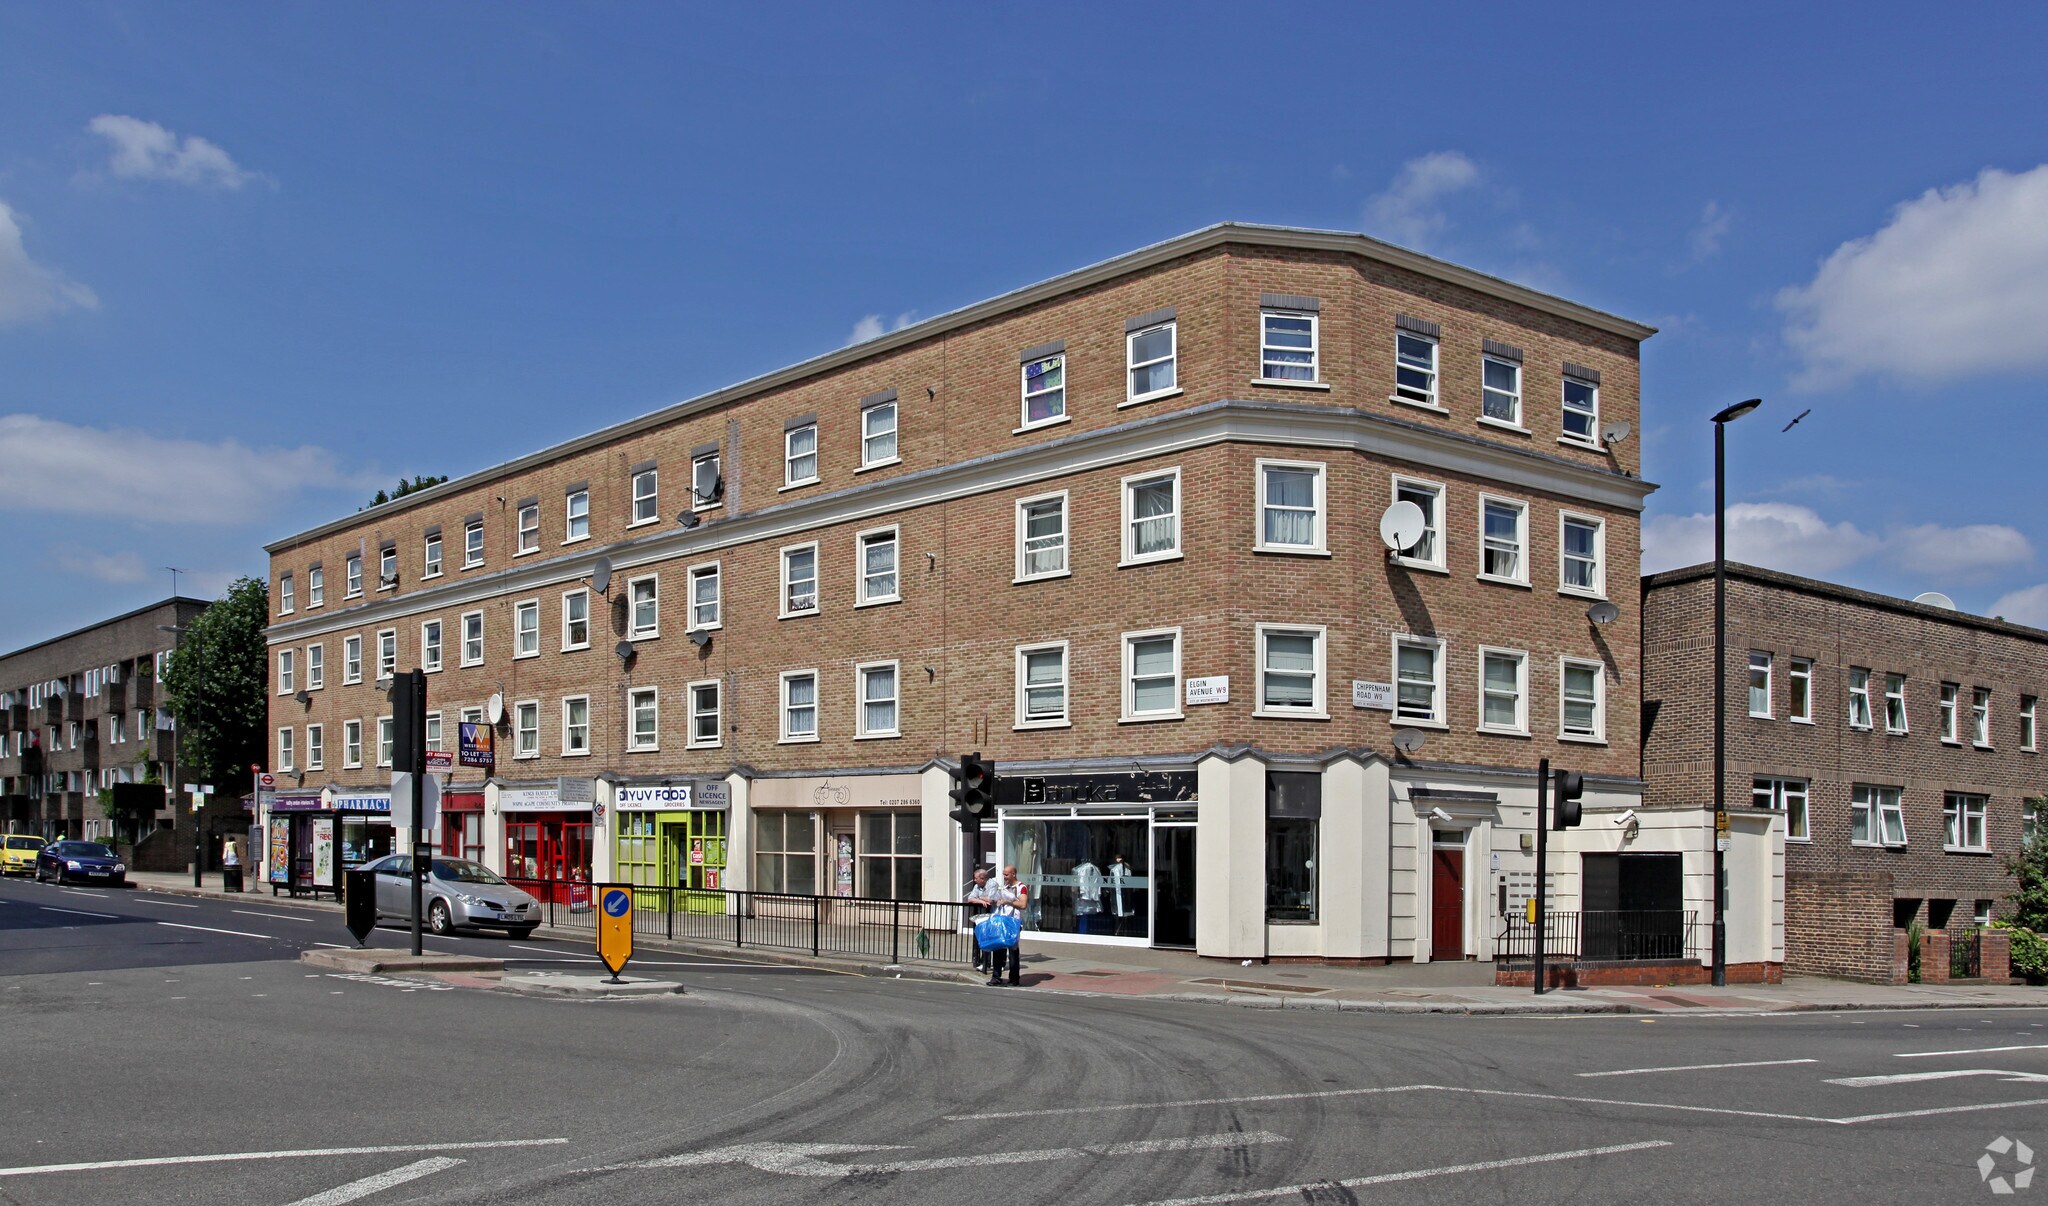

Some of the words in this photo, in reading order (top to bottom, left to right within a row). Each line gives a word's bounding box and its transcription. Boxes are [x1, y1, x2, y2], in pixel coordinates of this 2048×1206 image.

[1190, 680, 1206, 688] ELGIN
[1356, 683, 1390, 693] CHIPPENHAM
[1190, 687, 1212, 695] AVENUE
[1356, 691, 1371, 699] ROAD
[619, 790, 652, 801] DIYUV
[655, 789, 687, 801] FOOD
[338, 799, 388, 809] PHARMACY
